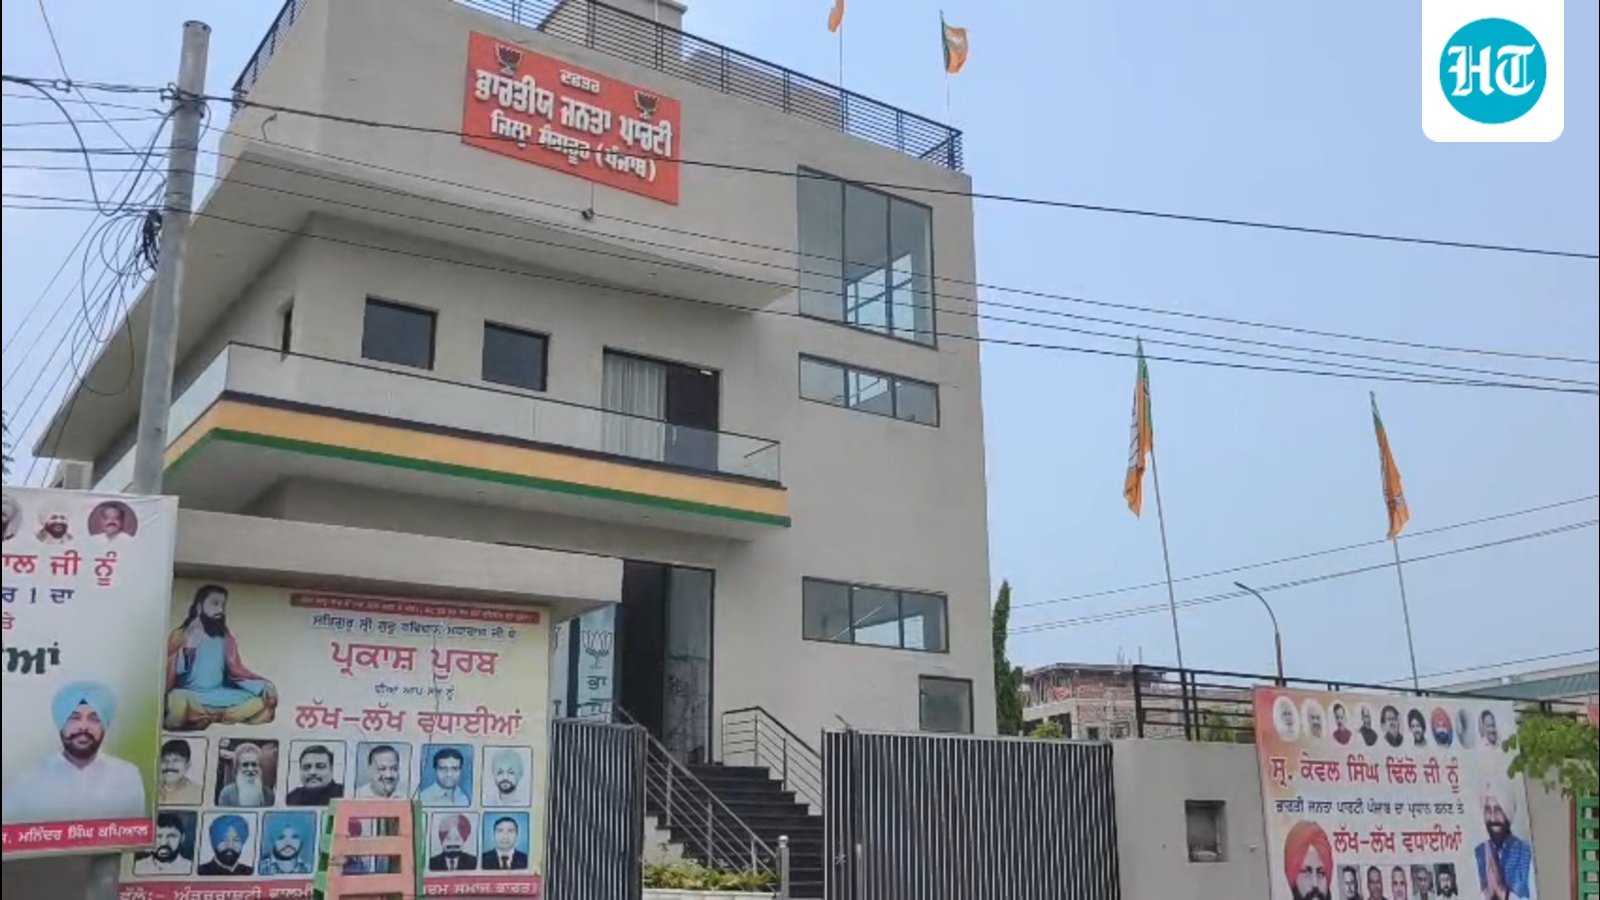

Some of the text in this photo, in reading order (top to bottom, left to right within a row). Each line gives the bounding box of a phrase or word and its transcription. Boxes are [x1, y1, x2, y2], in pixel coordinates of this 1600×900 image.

[560, 96, 612, 135] ਜਨਤਾ
[619, 114, 673, 158] ਪਾਰਟੀ
[50, 550, 82, 576] ਜੀ
[94, 551, 117, 587] ਨੂੰ
[50, 589, 75, 604] ਦਾ
[431, 648, 498, 680] ਪੁਰਬ
[295, 697, 406, 732] ਲੱਖ-ਲੱਖ
[417, 705, 522, 736] ਵਧਾਈਆਂ
[1300, 752, 1340, 783] ਕੇਵਲ
[1347, 754, 1379, 784] ਸਿੰਘ
[1423, 757, 1440, 785] ਜੀ
[1447, 757, 1459, 794] ਨੂੰ
[68, 824, 94, 840] ਸਿੰਘ
[1333, 823, 1462, 853] ਲੱਖ-ਲੱਖ ਵਧਾਈਆਂ
